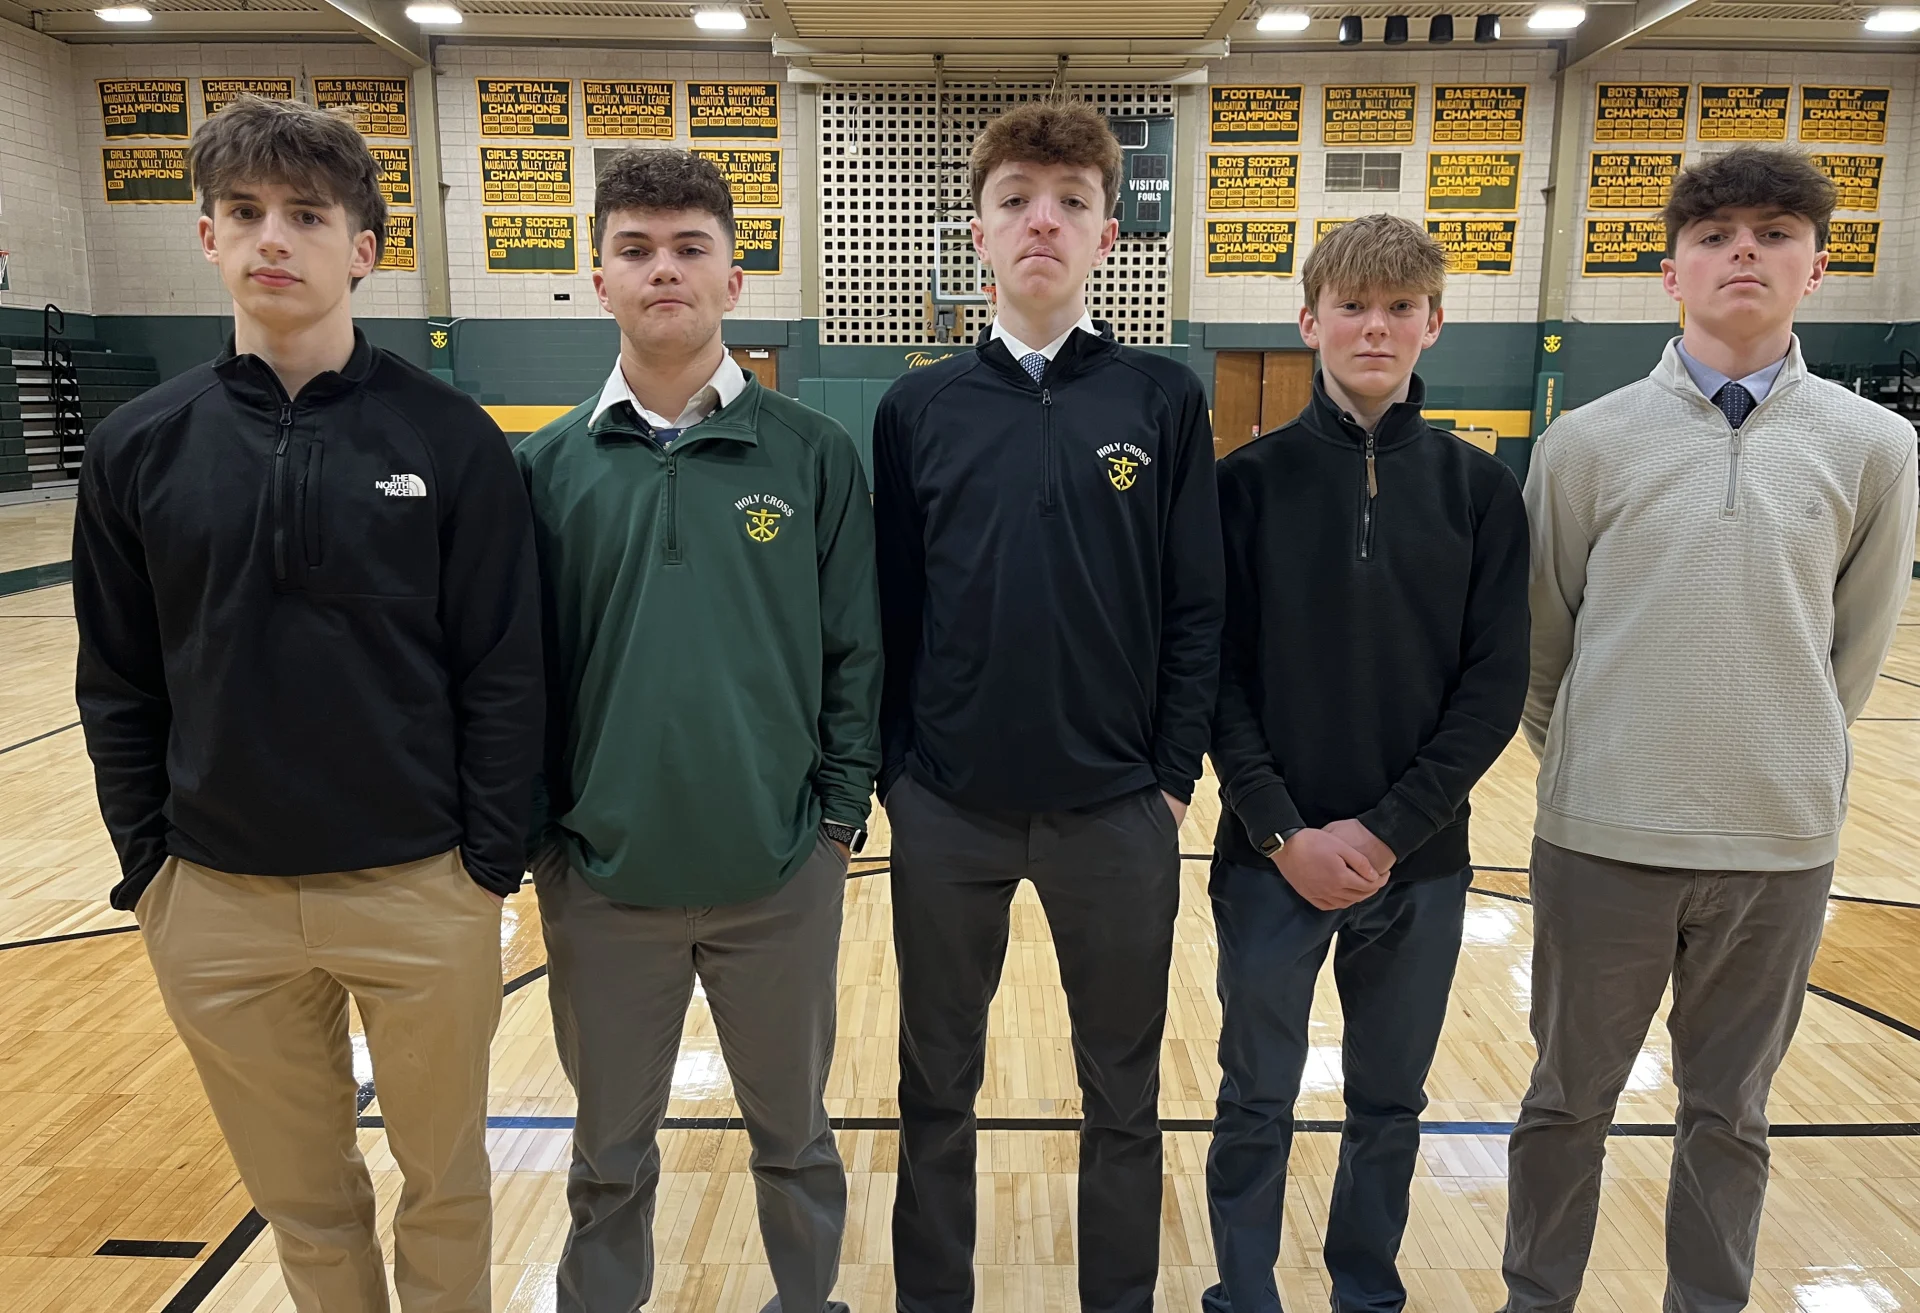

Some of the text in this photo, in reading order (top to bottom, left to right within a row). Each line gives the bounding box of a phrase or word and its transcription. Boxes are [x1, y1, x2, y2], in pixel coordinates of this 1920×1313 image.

[104, 82, 181, 93] CHEERLEADING
[208, 82, 287, 91] CHEERLEADING
[318, 81, 402, 92] GIRLS BASKETBALL
[488, 83, 558, 93] SOFTBALL
[587, 84, 669, 95] GIRLS VOLLEYBALL
[700, 86, 765, 95] GIRLS SWIMMING
[318, 92, 404, 102] NAUGATUCK VALLEY LEAGUE
[1222, 90, 1290, 99] FOOTBALL
[1330, 89, 1411, 99] BOYS BASKETBALL
[1445, 89, 1515, 99] BASEBALL
[1608, 88, 1679, 97] BOYS TENNIS
[1728, 89, 1763, 98] GOLF
[1828, 90, 1863, 99] GOLF
[103, 93, 184, 103] NAUGATUCK VALLEY LEAGUE
[481, 93, 567, 103] NAUGATUCK VALLEY LEAGUE
[587, 94, 670, 105] NAUGATUCK VALLEY LEAGUE
[691, 96, 775, 106] NAUGATUCK VALLEY LEAGUE
[109, 104, 179, 113] CHAMPIONS
[489, 104, 560, 114] CHAMPIONS
[593, 105, 665, 115] CHAMPIONS
[1251, 101, 1272, 110] VALLEY
[1276, 101, 1298, 110] LEAGUE
[698, 107, 769, 116] CHAMPIONS
[1333, 110, 1406, 120] CHAMPIONS
[1443, 110, 1516, 119] CHAMPIONS
[1605, 109, 1678, 118] CHAMPIONS
[1709, 109, 1778, 118] CHAMPIONS
[1810, 110, 1878, 120] CHAMPIONS
[1220, 112, 1292, 121] CHAMPIONS
[111, 150, 183, 159] GIRLS INDOOR TRACK
[487, 150, 564, 160] GIRLS SOCCER
[699, 152, 771, 162] GIRLS TENNIS
[107, 160, 187, 169] NAUGATUCK VALLEY LEAGU
[1218, 157, 1289, 167] BOYS SOCCER
[1441, 156, 1509, 165] BASEBALL
[1601, 156, 1672, 165] BOYS TENNIS
[385, 162, 407, 171] LEAGUE
[485, 161, 567, 171] NAUGATUCK VALLEY LEAGUE
[729, 163, 750, 172] VALLEY
[754, 163, 776, 172] LEAGUE
[1469, 166, 1491, 175] VALLEY
[114, 170, 183, 179] CHAMPIONS
[491, 171, 563, 181] CHAMPIONS
[1211, 167, 1295, 177] NAUGATUCK VALLEY LEAGUE
[720, 173, 771, 182] MPIONS
[1437, 177, 1509, 186] CHAMPIONS
[1598, 177, 1671, 186] CHAMPIONS
[1129, 180, 1169, 191] VISITOR
[1217, 178, 1288, 187] CHAMPIONS
[492, 218, 567, 227] GIRLS SOCCER
[736, 221, 772, 229] TENNIS
[1439, 223, 1504, 231] BOYS SWIMMING
[1216, 224, 1288, 233] BOYS SOCCER
[1596, 223, 1666, 232] BOYS TENNIS
[389, 228, 411, 237] LEAGUE
[489, 228, 571, 238] NAUGATUCK VALLEY LEAGUE
[736, 231, 777, 239] ALLEY LEAGUE
[1466, 232, 1488, 241] VALLEY
[1210, 234, 1293, 243] NAUGATUCK VALLEY LEAGUE
[496, 239, 565, 248] CHAMPIONS
[736, 241, 772, 249] PIONS
[1217, 243, 1287, 253] CHAMPIONS
[1444, 242, 1505, 251] HAMPIONS
[1593, 243, 1666, 252] CHAMPIONS
[1096, 442, 1151, 465] HOLY CROSS
[376, 481, 408, 489] NORTH
[735, 494, 794, 516] HOLY CROSS
